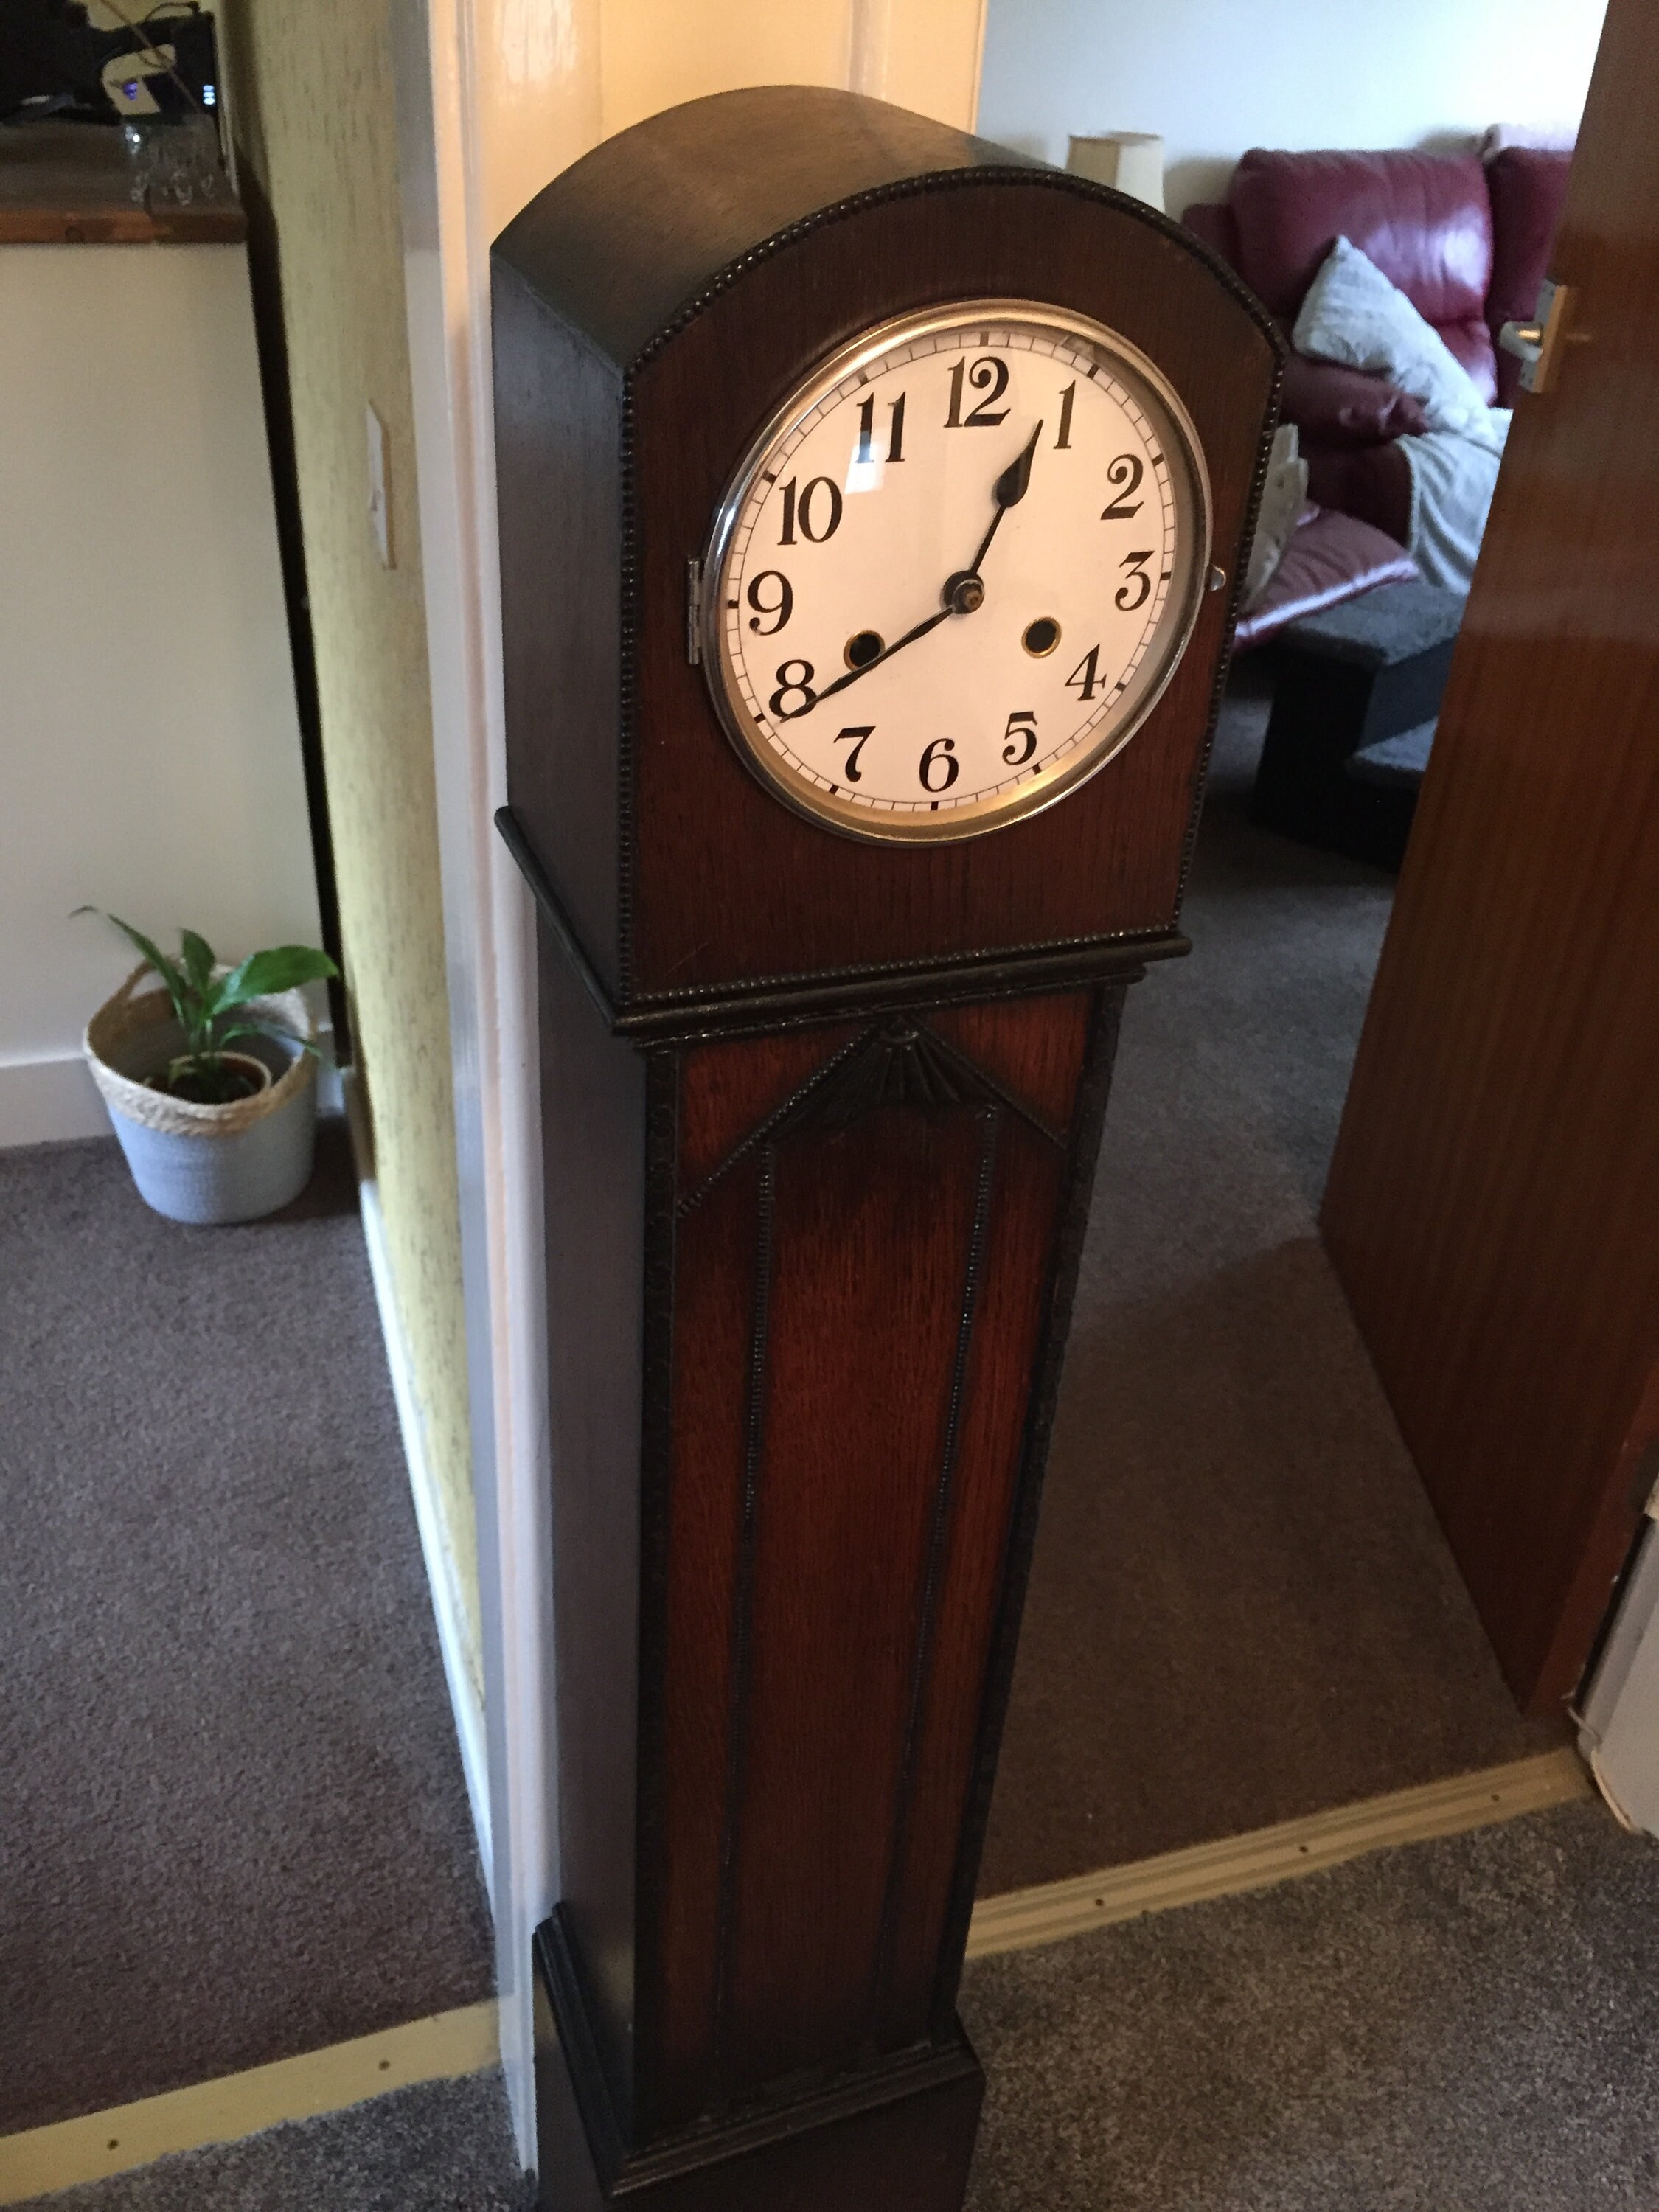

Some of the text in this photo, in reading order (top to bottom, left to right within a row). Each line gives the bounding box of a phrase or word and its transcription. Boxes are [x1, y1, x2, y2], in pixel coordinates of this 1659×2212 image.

[943, 355, 1012, 428] 12
[1053, 380, 1076, 450] 1
[855, 392, 906, 463] 11
[776, 476, 843, 546] 10
[1100, 453, 1144, 521] 2
[747, 570, 793, 636] 9
[1114, 550, 1155, 612] 3
[769, 658, 818, 719] 8
[1065, 643, 1107, 702] 4
[833, 726, 877, 783] 7
[919, 737, 959, 793] 6
[1001, 711, 1038, 766] 5
